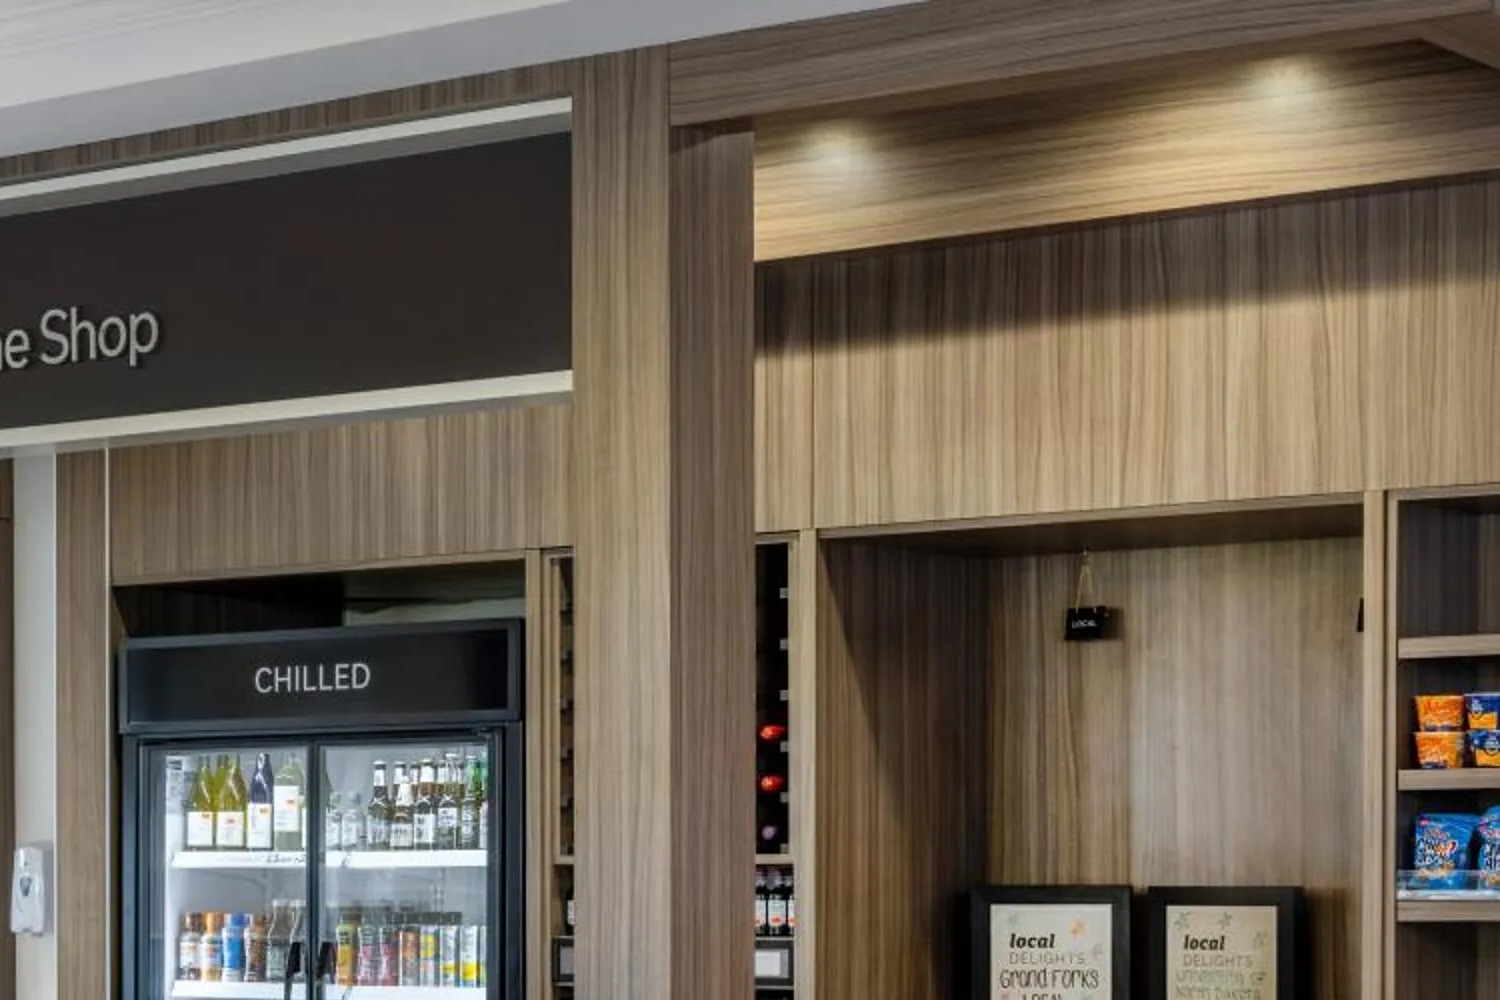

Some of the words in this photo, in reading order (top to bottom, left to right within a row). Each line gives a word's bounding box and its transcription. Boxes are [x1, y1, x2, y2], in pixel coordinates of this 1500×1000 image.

[39, 305, 160, 368] Shop
[254, 662, 372, 693] CHILLED
[1009, 932, 1056, 949] local
[1183, 934, 1225, 951] local
[1009, 951, 1085, 965] DELIGHTS
